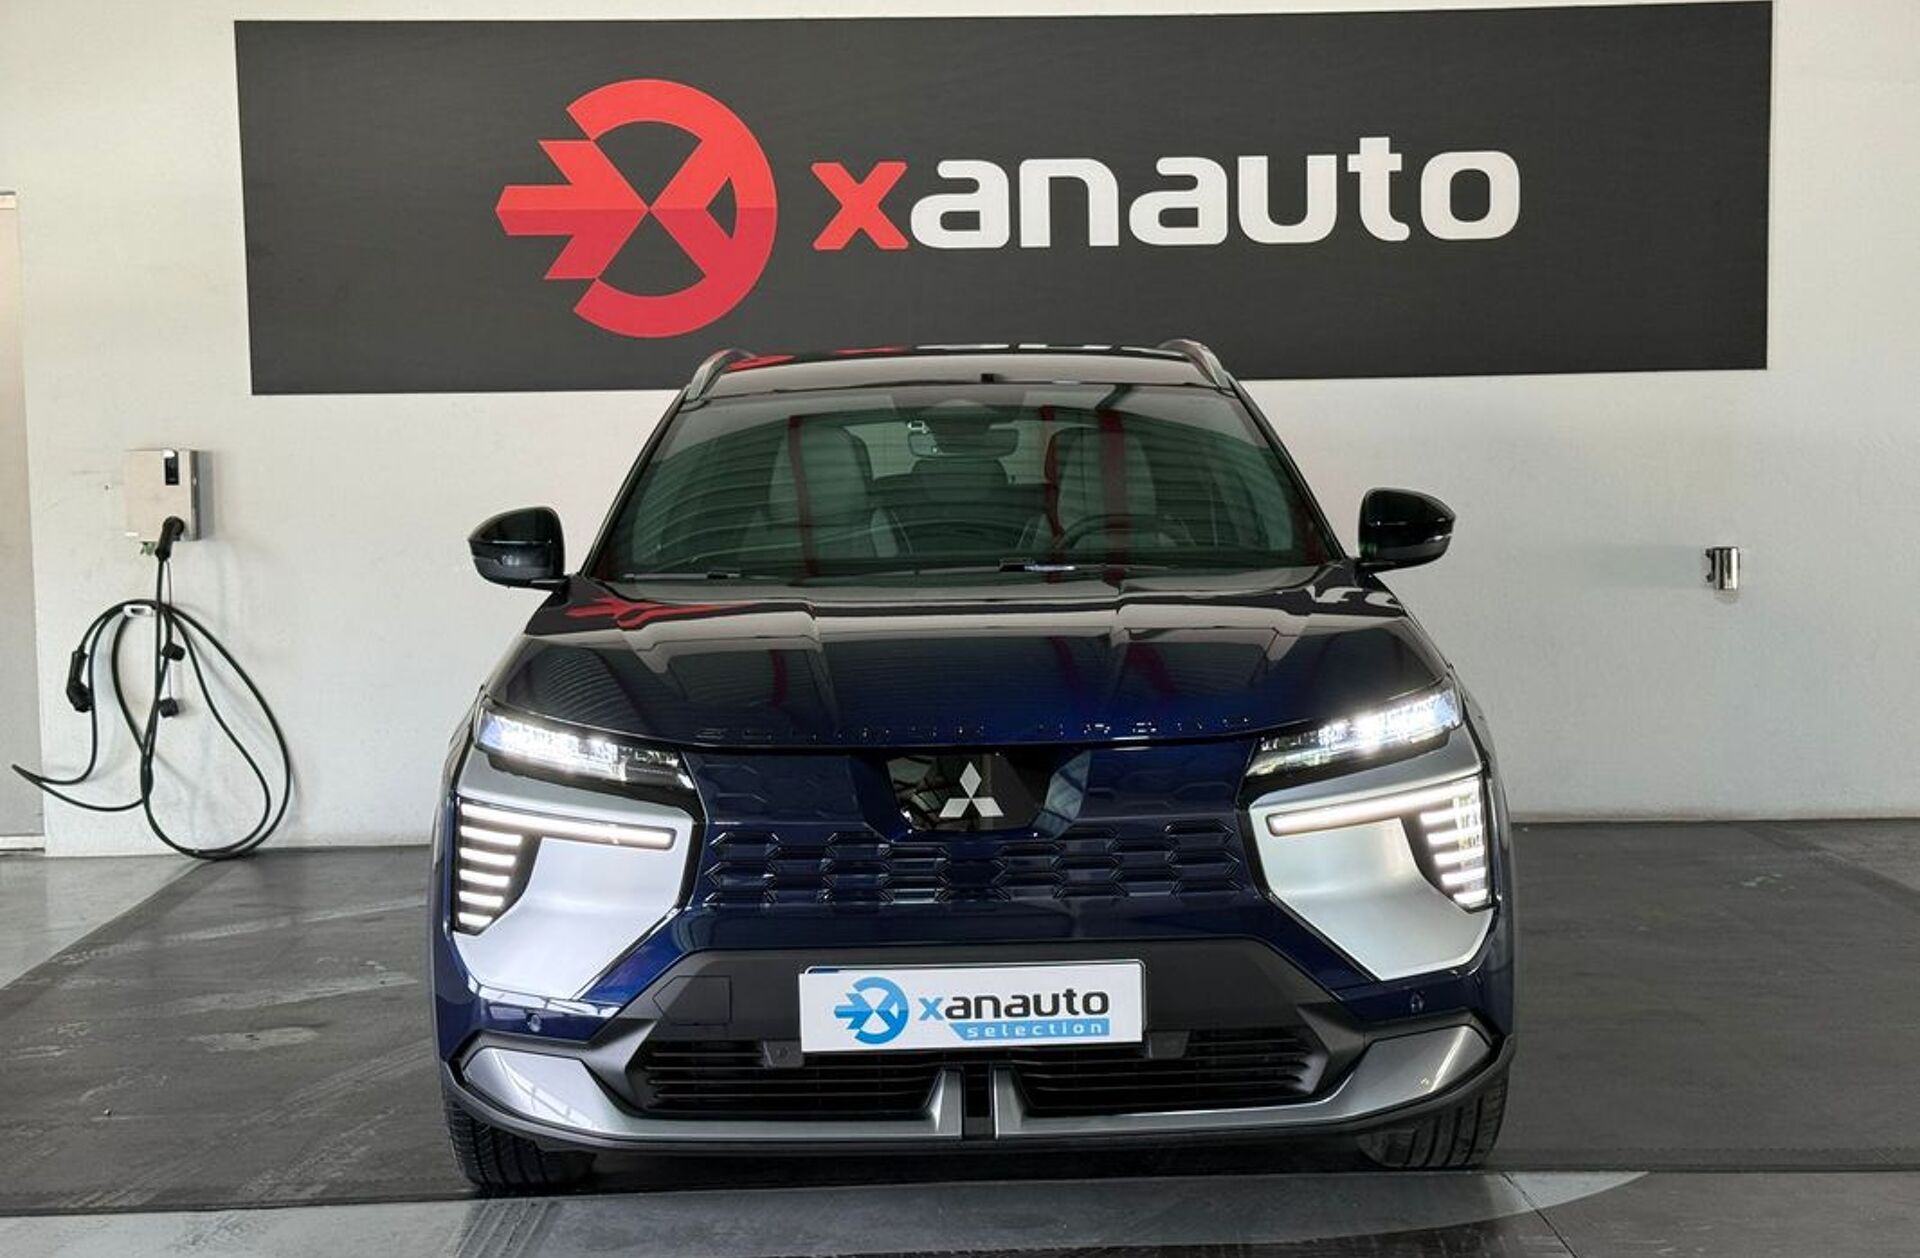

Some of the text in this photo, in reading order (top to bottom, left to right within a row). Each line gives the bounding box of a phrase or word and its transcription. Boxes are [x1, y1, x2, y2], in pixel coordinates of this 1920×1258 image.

[811, 137, 1520, 250] xanauto
[918, 988, 1109, 1022] xanauto
[966, 1021, 1103, 1038] selection
